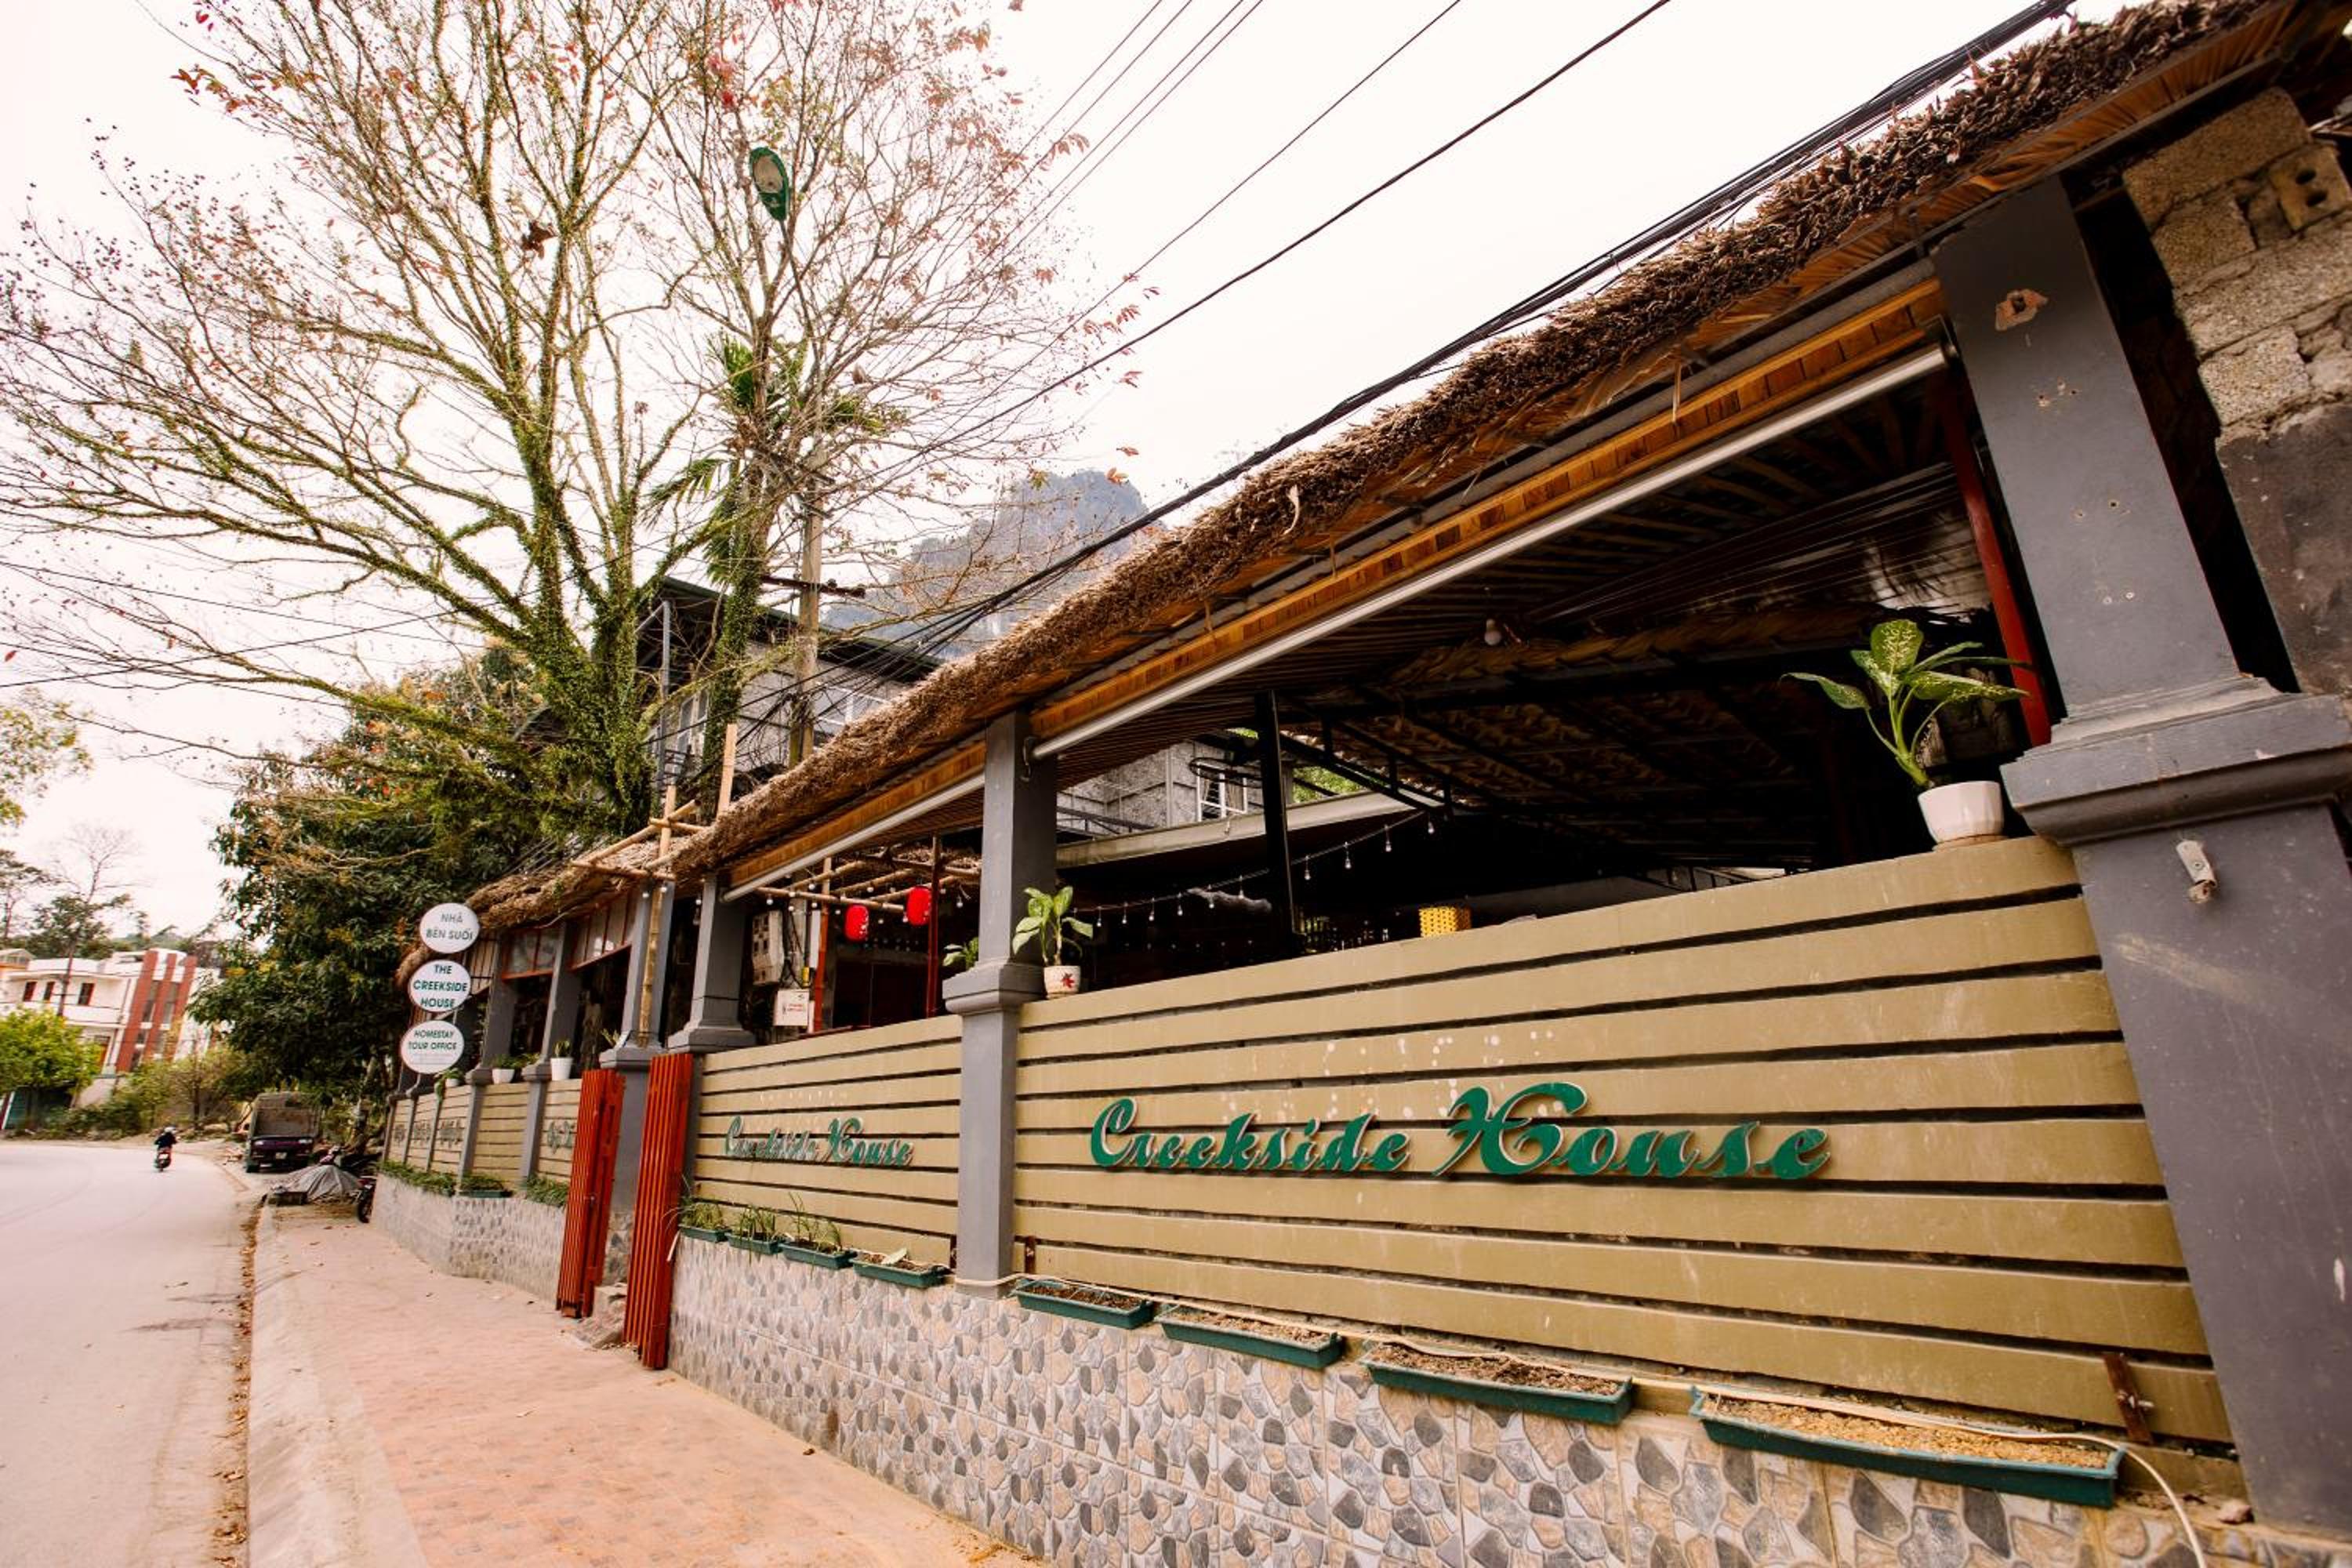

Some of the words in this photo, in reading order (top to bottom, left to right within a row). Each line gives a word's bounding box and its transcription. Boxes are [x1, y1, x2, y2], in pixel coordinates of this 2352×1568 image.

[434, 964, 452, 975] THE
[413, 979, 468, 992] CREEKSIDE
[420, 997, 455, 1008] HOUSE
[414, 1029, 454, 1039] HOMESTAY
[408, 1040, 428, 1050] TOUR
[430, 1042, 457, 1051] OFFICE
[1091, 1097, 1410, 1171] Creekside
[1431, 1081, 1831, 1178] House
